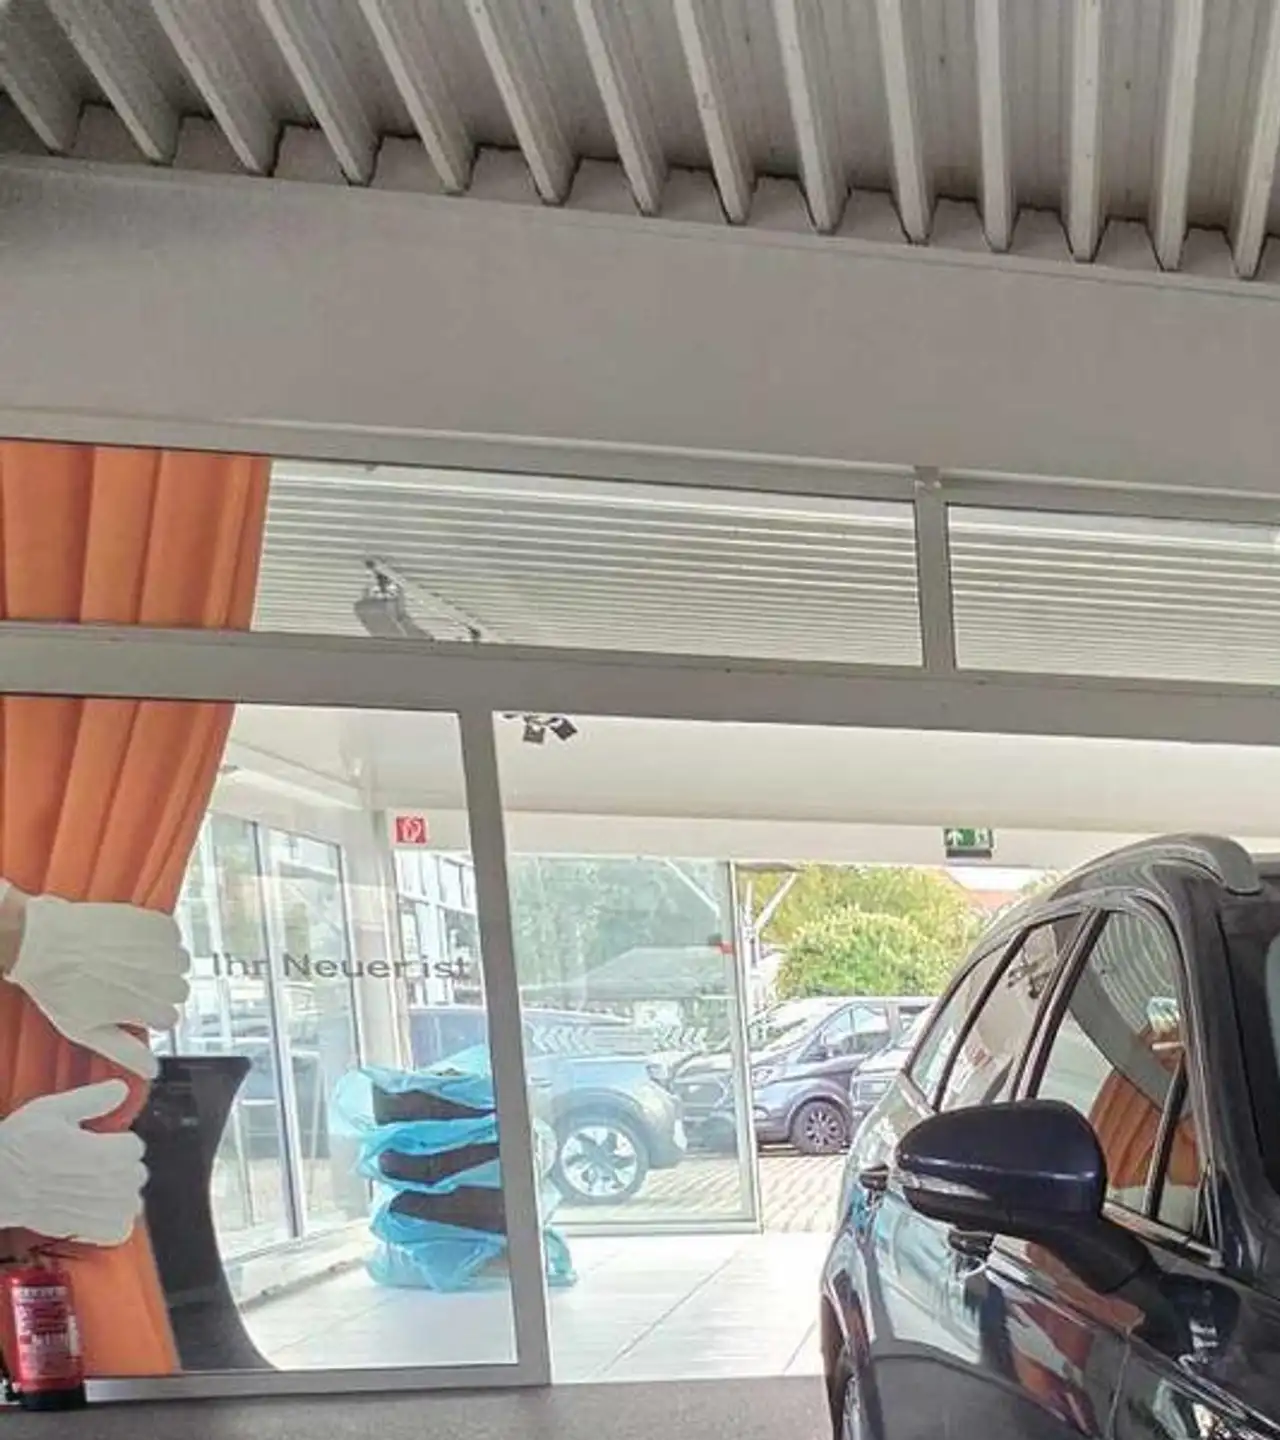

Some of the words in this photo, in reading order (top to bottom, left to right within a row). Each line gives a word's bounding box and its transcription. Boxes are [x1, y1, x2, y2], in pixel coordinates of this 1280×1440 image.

[212, 952, 267, 977] Ihr
[283, 952, 409, 979] Neuer
[420, 953, 471, 979] ist
